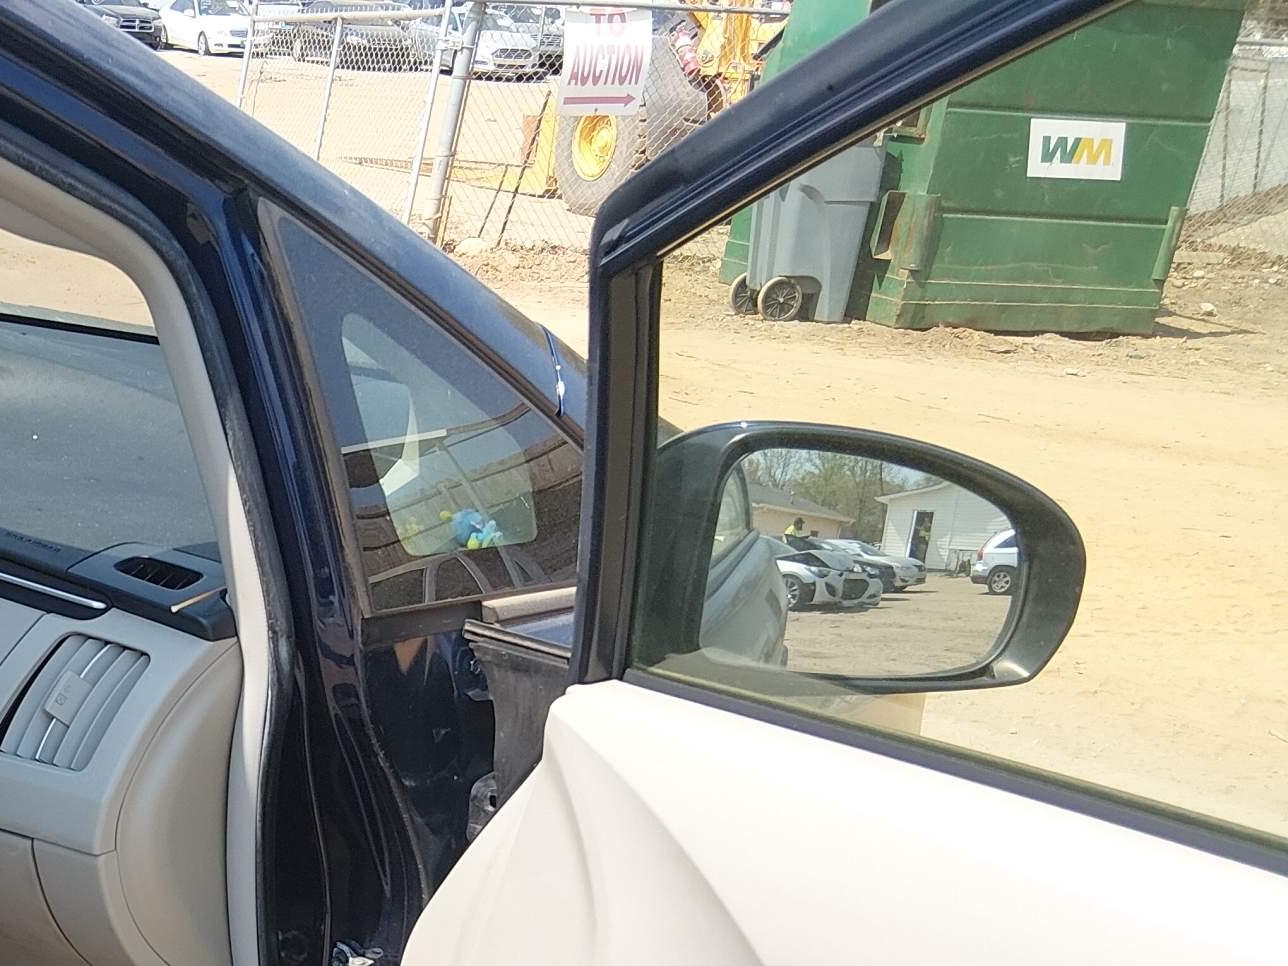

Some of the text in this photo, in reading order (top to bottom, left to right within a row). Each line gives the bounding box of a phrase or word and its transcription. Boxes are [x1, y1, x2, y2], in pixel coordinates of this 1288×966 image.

[589, 7, 627, 37] TO
[567, 43, 644, 87] AUCTION
[1040, 135, 1113, 167] WM
